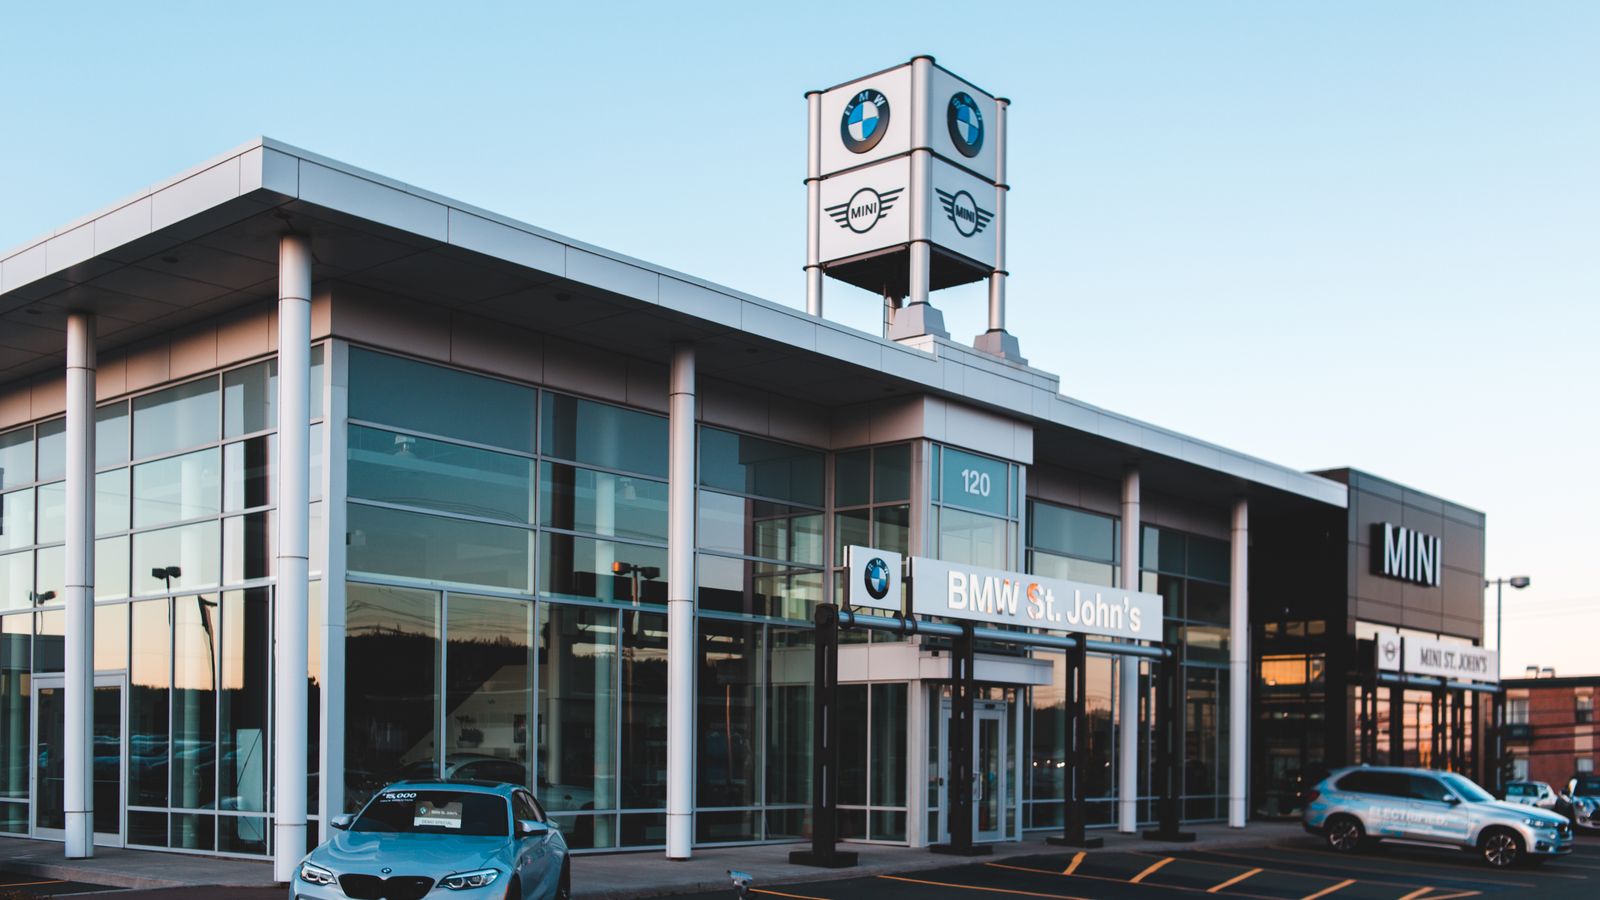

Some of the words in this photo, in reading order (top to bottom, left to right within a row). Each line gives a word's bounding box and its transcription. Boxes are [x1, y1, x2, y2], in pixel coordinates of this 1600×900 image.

[851, 202, 877, 219] MINI
[955, 204, 975, 223] MINI
[961, 469, 991, 497] 120
[1384, 521, 1441, 587] MINI
[948, 570, 1019, 616] BMW
[1026, 583, 1061, 622] St.
[1066, 590, 1142, 633] John's
[1420, 647, 1442, 667] MINI
[1444, 650, 1456, 670] ST.
[1459, 653, 1488, 673] JOHN'S
